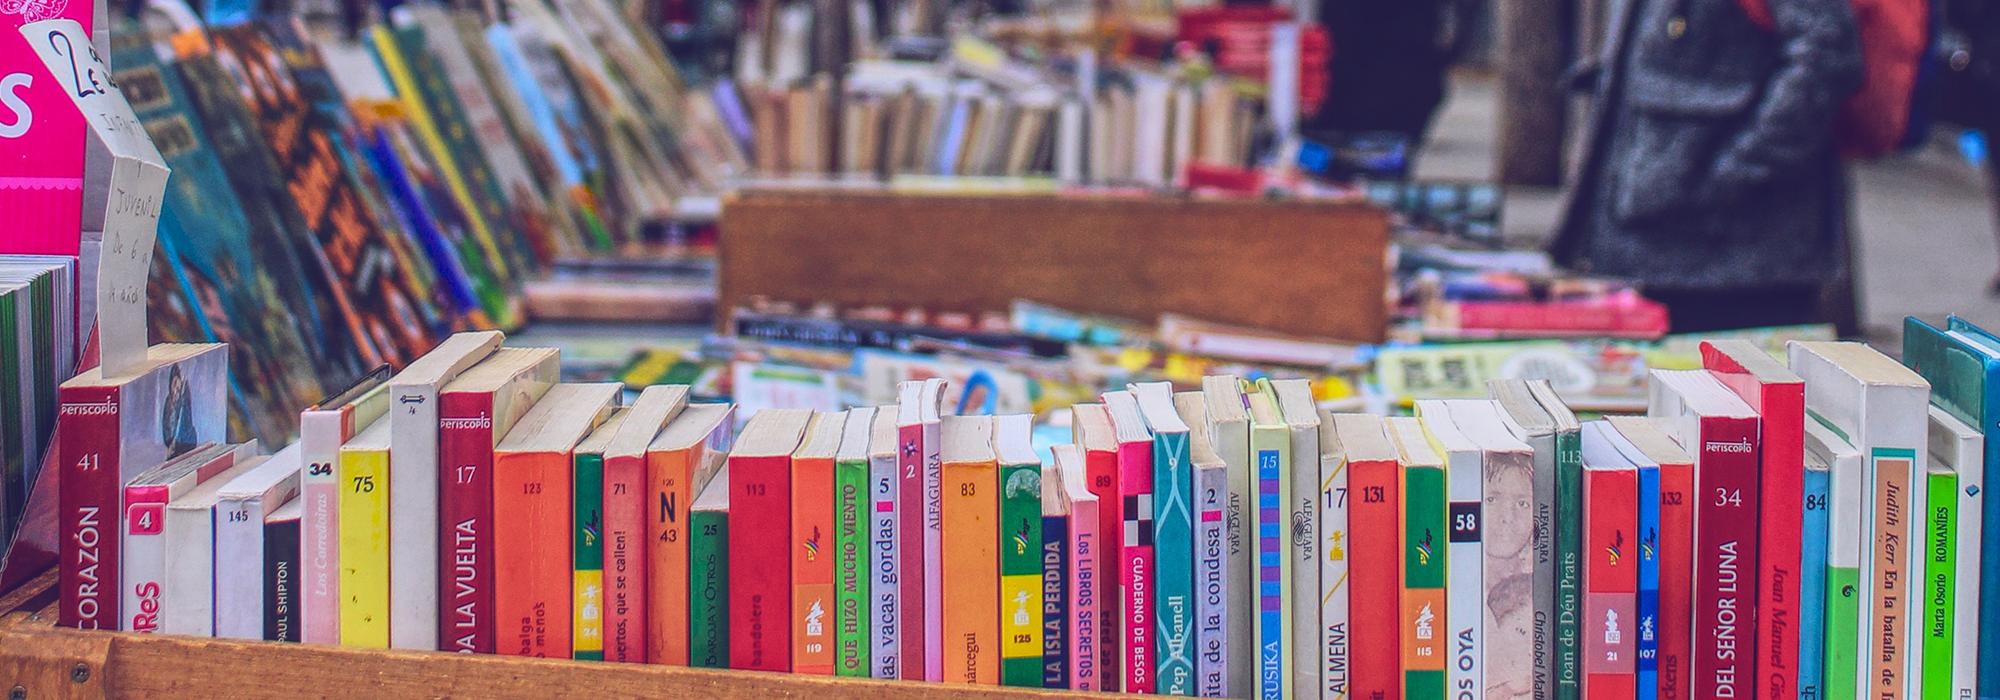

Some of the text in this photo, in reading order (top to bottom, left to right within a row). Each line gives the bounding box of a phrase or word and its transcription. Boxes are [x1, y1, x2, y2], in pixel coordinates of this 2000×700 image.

[77, 452, 99, 471] 41
[1168, 457, 1177, 470] 9
[1261, 456, 1277, 469] 15
[1561, 451, 1581, 464] 113
[309, 462, 332, 476] 34
[456, 465, 476, 485] 17
[906, 464, 916, 479] 2
[353, 475, 375, 493] 75
[523, 483, 542, 494] 123
[614, 483, 626, 495] 71
[746, 484, 765, 496] 113
[879, 477, 889, 494] 5
[928, 452, 940, 531] ALFAGUARA
[961, 482, 976, 497] 83
[1096, 475, 1111, 488] 89
[1206, 488, 1216, 504] 2
[1324, 488, 1347, 509] 17
[1363, 486, 1385, 503] 131
[1661, 492, 1682, 505] 132
[1715, 487, 1742, 507] 34
[1806, 494, 1825, 511] 84
[1886, 481, 1900, 526] Judith
[228, 510, 249, 522] 145
[660, 492, 675, 523] N
[138, 511, 152, 529] 4
[704, 525, 717, 536] 25
[1230, 492, 1240, 556] ALFAGUARA
[1303, 498, 1313, 561] ALFAGUARA
[1455, 513, 1476, 531] 58
[660, 529, 677, 543] 43
[1540, 503, 1548, 564] ALFAGUARA
[614, 530, 626, 573] callen!
[876, 518, 897, 584] gordas
[1884, 532, 1899, 564] Kerr
[457, 518, 476, 600] VUELTA
[1204, 526, 1220, 605] condesa
[617, 575, 626, 590] se
[843, 484, 860, 670] QUE HIZO MUCHO VIENTO
[1884, 569, 1898, 590] En
[1933, 506, 1948, 638] Marta Osorio ROMANÍES
[277, 561, 288, 614] SHIPTON
[1078, 559, 1093, 607] LIBROS
[1773, 565, 1788, 602] Joan
[617, 592, 629, 615] que
[1044, 540, 1061, 682] LA ISLA PERDIDA
[1884, 595, 1897, 609] la
[457, 602, 476, 627] LA
[533, 601, 545, 647] menos
[881, 593, 894, 648] vacas
[1133, 556, 1144, 684] CUADERNO DE BESOS
[1204, 613, 1220, 633] la
[1559, 552, 1577, 687] Joan de Déu Prats
[1713, 541, 1738, 699] DEL SEÑOR LUNA
[752, 594, 762, 667] bandolero
[1013, 634, 1031, 644] 125
[1534, 610, 1547, 668] Christobel
[1771, 608, 1788, 669] Manuel
[1882, 616, 1897, 664] batalla
[806, 643, 822, 653] 119
[1078, 610, 1093, 679] SECRETOS
[1204, 640, 1220, 663] de
[1417, 647, 1432, 656] 115
[1458, 627, 1474, 672] OYA
[1639, 650, 1656, 659] 107
[1329, 622, 1346, 695] ALMENA
[1607, 651, 1618, 661] 21
[1264, 640, 1278, 700] RUSIKA
[1882, 668, 1895, 686] de
[1170, 666, 1188, 696] Pep
